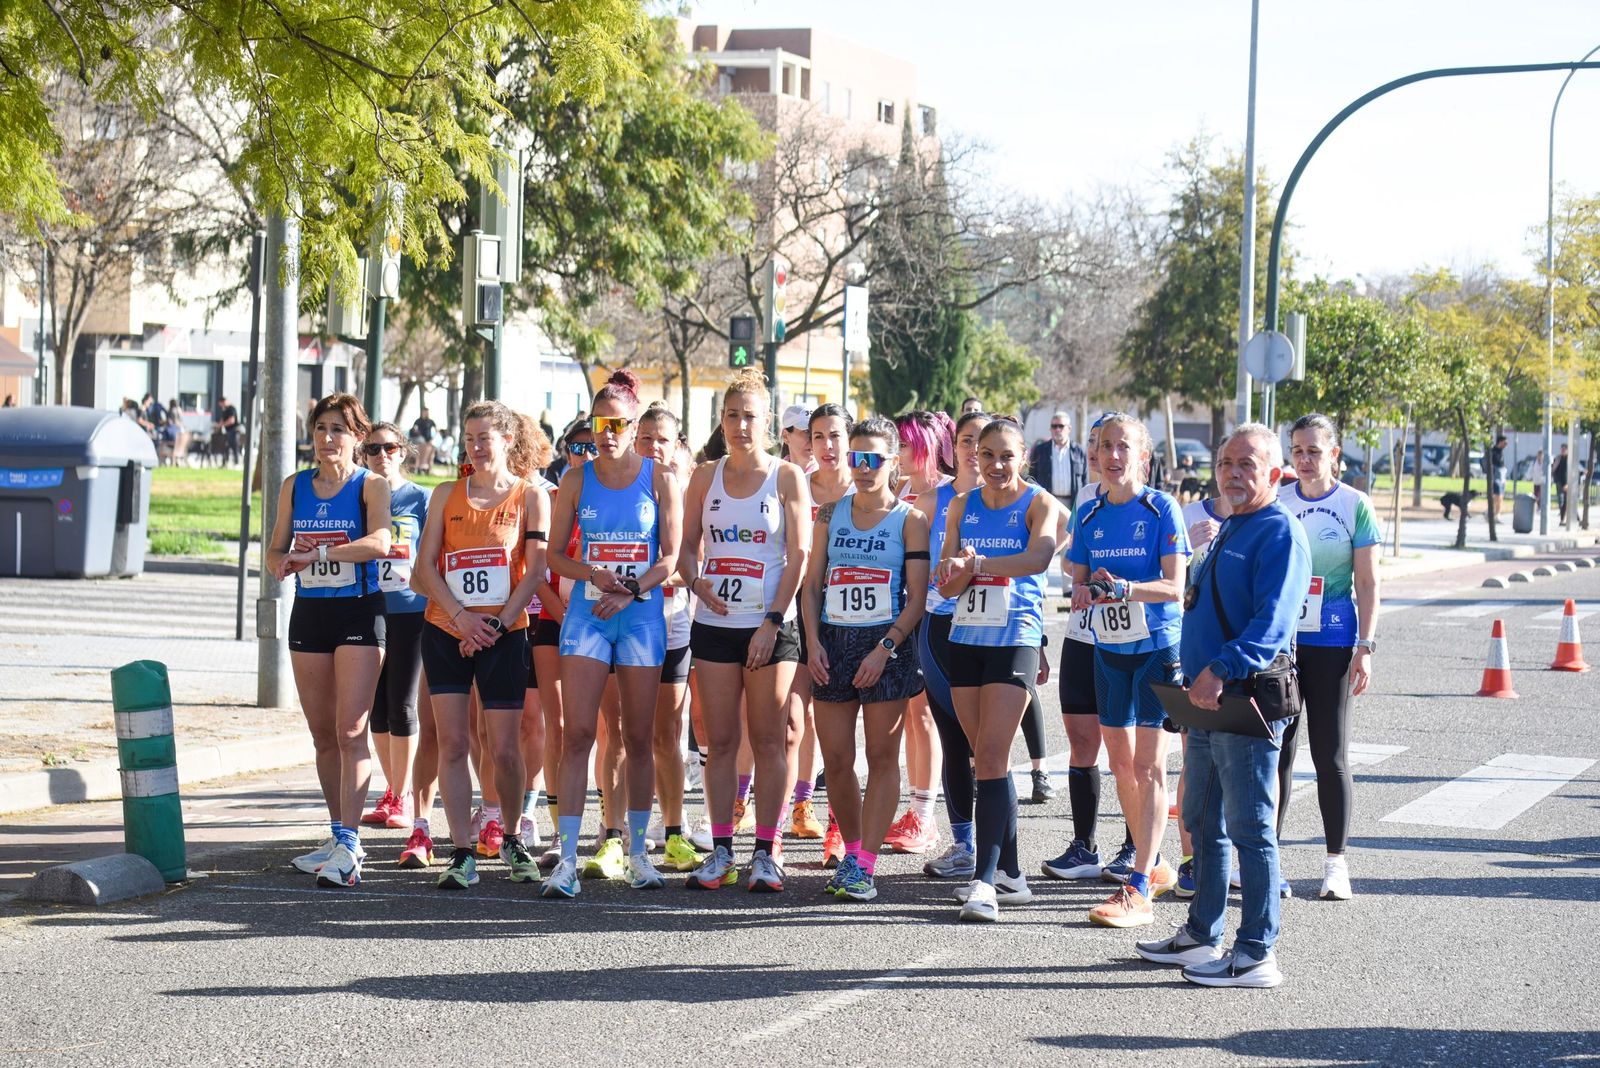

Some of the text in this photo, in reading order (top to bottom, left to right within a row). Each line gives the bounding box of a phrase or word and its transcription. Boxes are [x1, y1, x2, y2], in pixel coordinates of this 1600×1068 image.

[293, 519, 356, 529] TROTASIERRA
[585, 531, 652, 541] TROTASIERRA
[710, 524, 767, 544] indea
[833, 536, 886, 553] nerja
[960, 538, 1022, 549] TROTASIERRA
[840, 552, 878, 561] ATLETISMO
[1091, 548, 1147, 558] TROTASIERRA
[463, 570, 489, 594] 86
[717, 577, 742, 603] 42
[839, 586, 876, 612] 195
[967, 588, 987, 613] 91
[1101, 605, 1131, 632] 189
